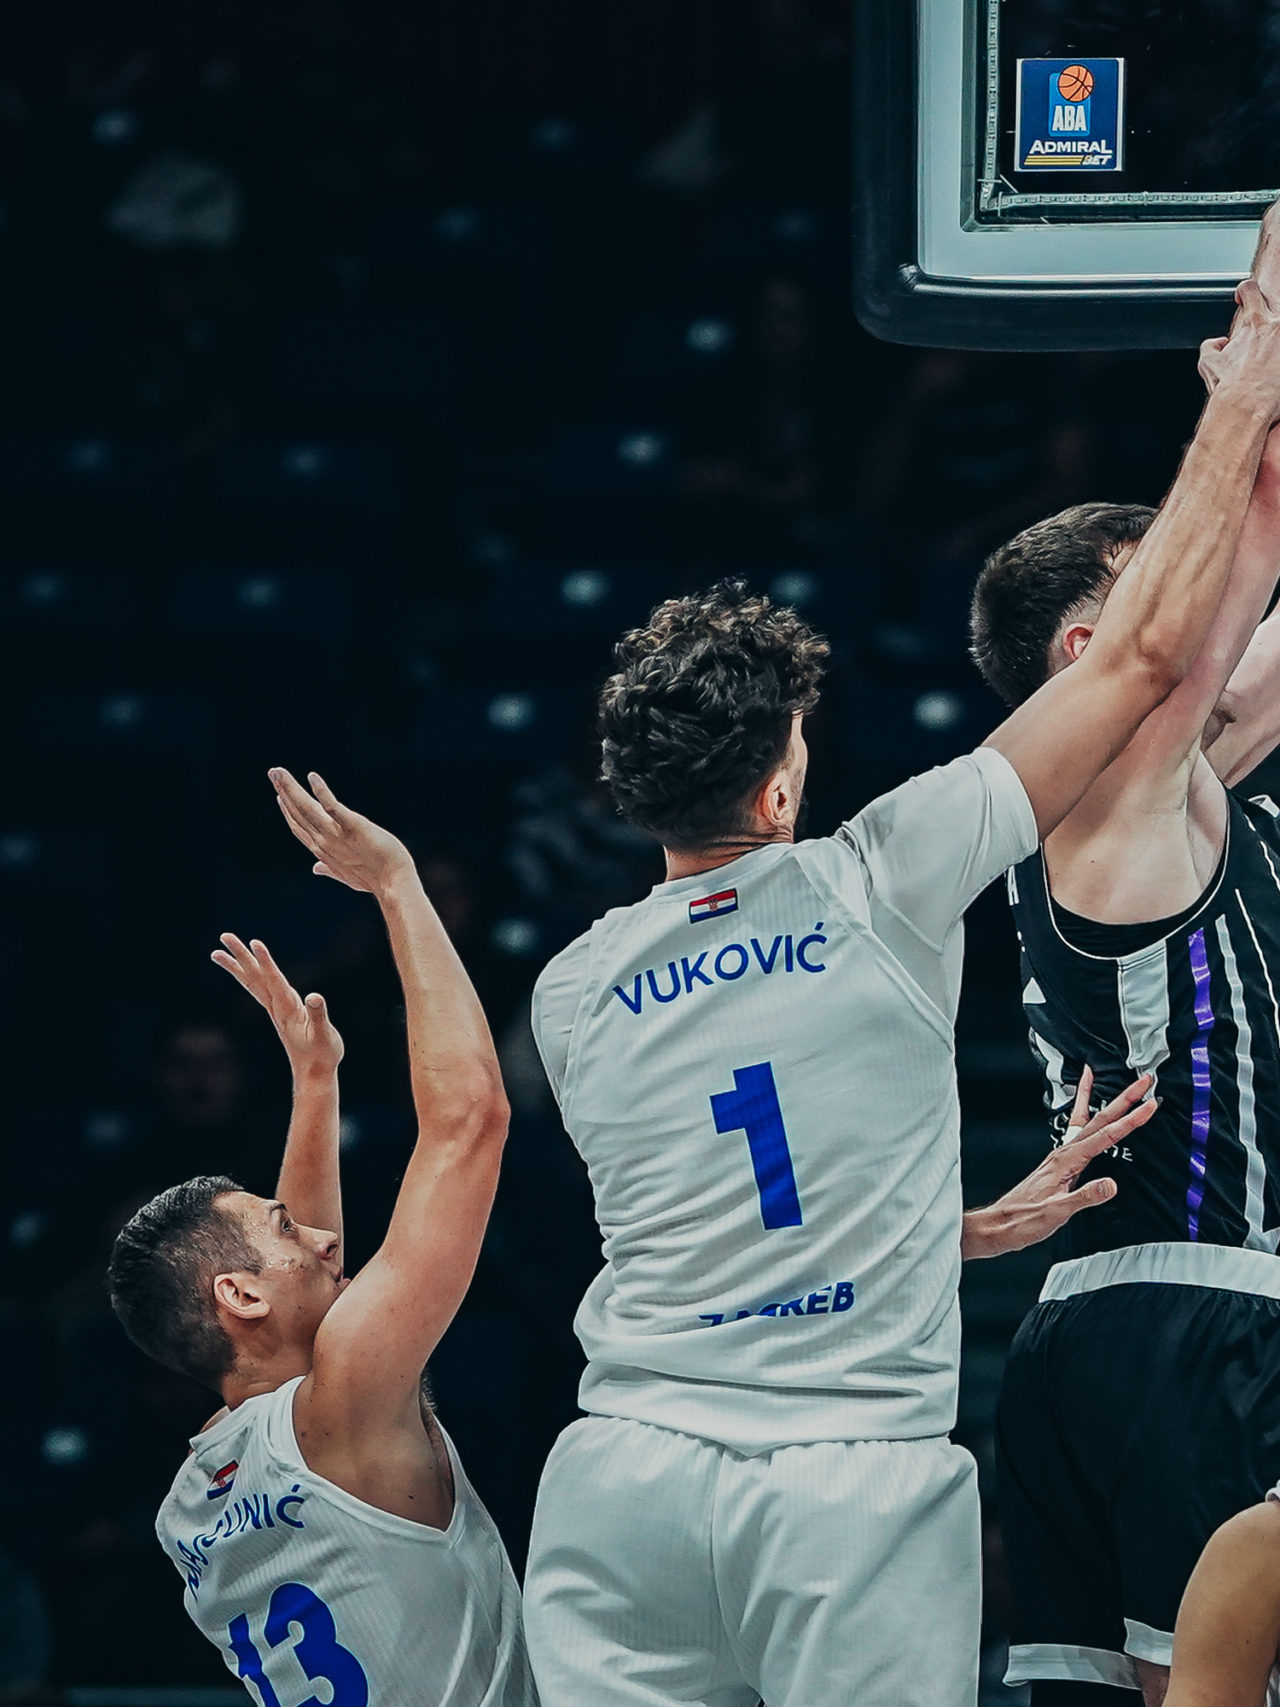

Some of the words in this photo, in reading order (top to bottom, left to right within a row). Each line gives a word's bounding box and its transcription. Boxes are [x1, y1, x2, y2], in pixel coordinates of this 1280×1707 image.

[1029, 139, 1113, 154] ADMIRAL
[1052, 105, 1087, 131] ABA
[1082, 155, 1112, 165] BET
[612, 922, 827, 1015] VUKOVIĆ
[709, 1062, 803, 1230] 1
[228, 1581, 369, 1707] 13
